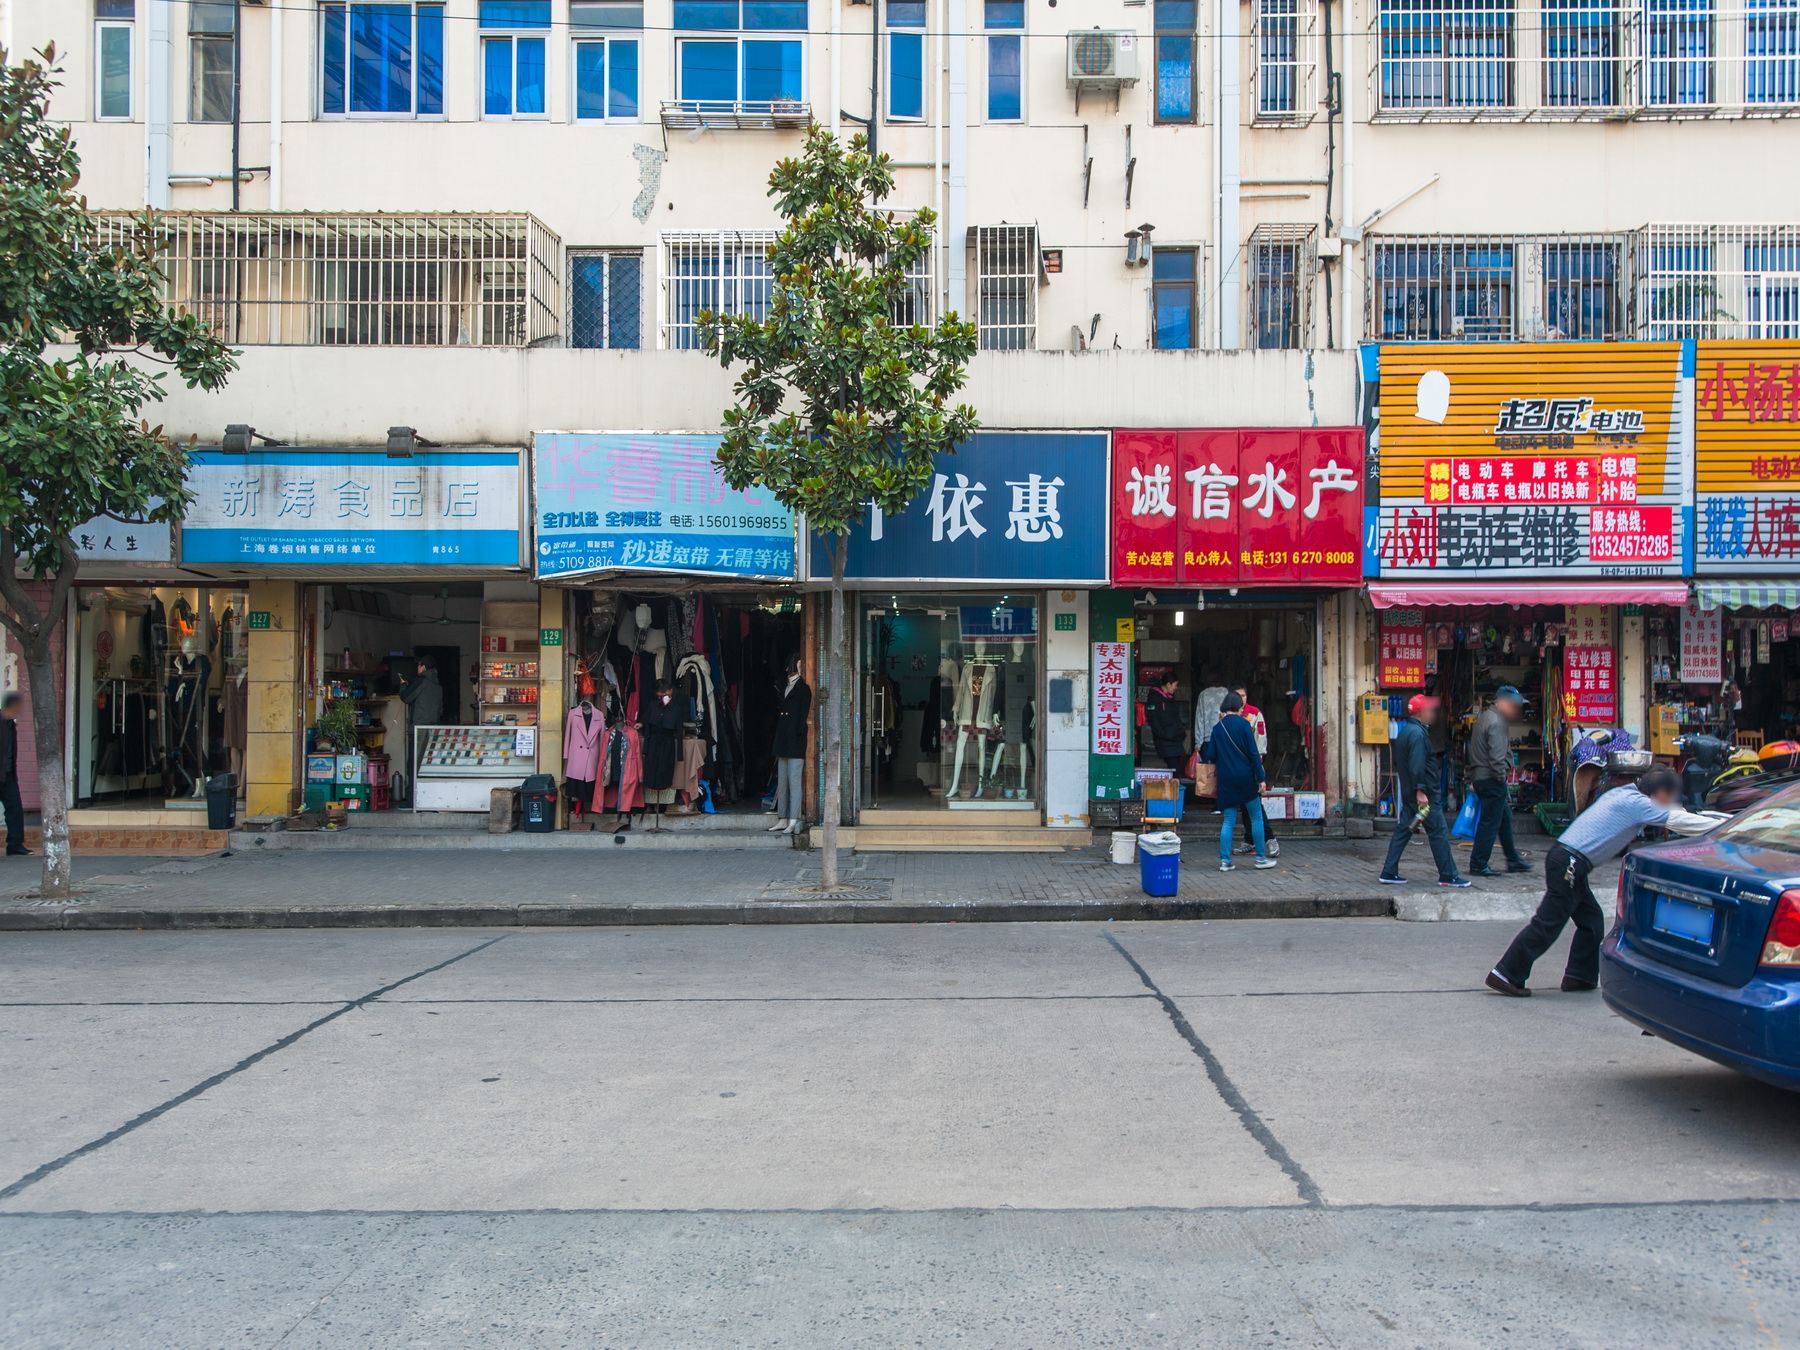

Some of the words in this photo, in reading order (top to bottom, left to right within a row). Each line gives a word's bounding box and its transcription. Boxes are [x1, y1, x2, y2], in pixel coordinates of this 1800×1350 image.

[1494, 397, 1645, 434] 超威电池
[543, 439, 781, 505] 华睿制
[1457, 461, 1515, 479] 电动车
[1532, 461, 1590, 479] 摩托车
[1601, 457, 1637, 478] 电焊
[1125, 459, 1358, 520] 诚信水产
[1430, 463, 1450, 502] 精修
[1457, 482, 1500, 500] 电瓶车
[1504, 481, 1590, 500] 电瓶以旧换新
[223, 476, 480, 518] 新涛食品店
[1601, 481, 1637, 502] 补胎
[670, 514, 695, 528] 电话:
[699, 515, 787, 529] 15601969855
[1380, 505, 1580, 568] 小刘电动车维修
[240, 543, 376, 554] 上海卷烟销售网络单位
[1591, 535, 1669, 557] 13524573285
[559, 557, 585, 569] 5109
[587, 556, 614, 568] 8816
[620, 539, 710, 566] 秒速宽带
[715, 548, 791, 570] 无需等待
[1126, 551, 1174, 566] 苦心经营
[1184, 551, 1232, 566] 良心待人
[1326, 551, 1354, 564] 8008
[252, 613, 267, 623] 127
[1058, 616, 1073, 625] 133
[1569, 617, 1608, 628] 电动车
[1684, 620, 1718, 630] 电瓶车
[544, 631, 559, 640] 129
[1568, 630, 1608, 640] 摩托车
[1684, 633, 1718, 643] 自行车
[1096, 644, 1126, 657] 专卖
[1568, 651, 1611, 667] 专业修理
[1684, 658, 1718, 668] 以旧换新
[1570, 669, 1610, 680] 电瓶车
[1097, 659, 1123, 753] 太湖红膏大闸蟹
[1565, 692, 1577, 718] 补胎
